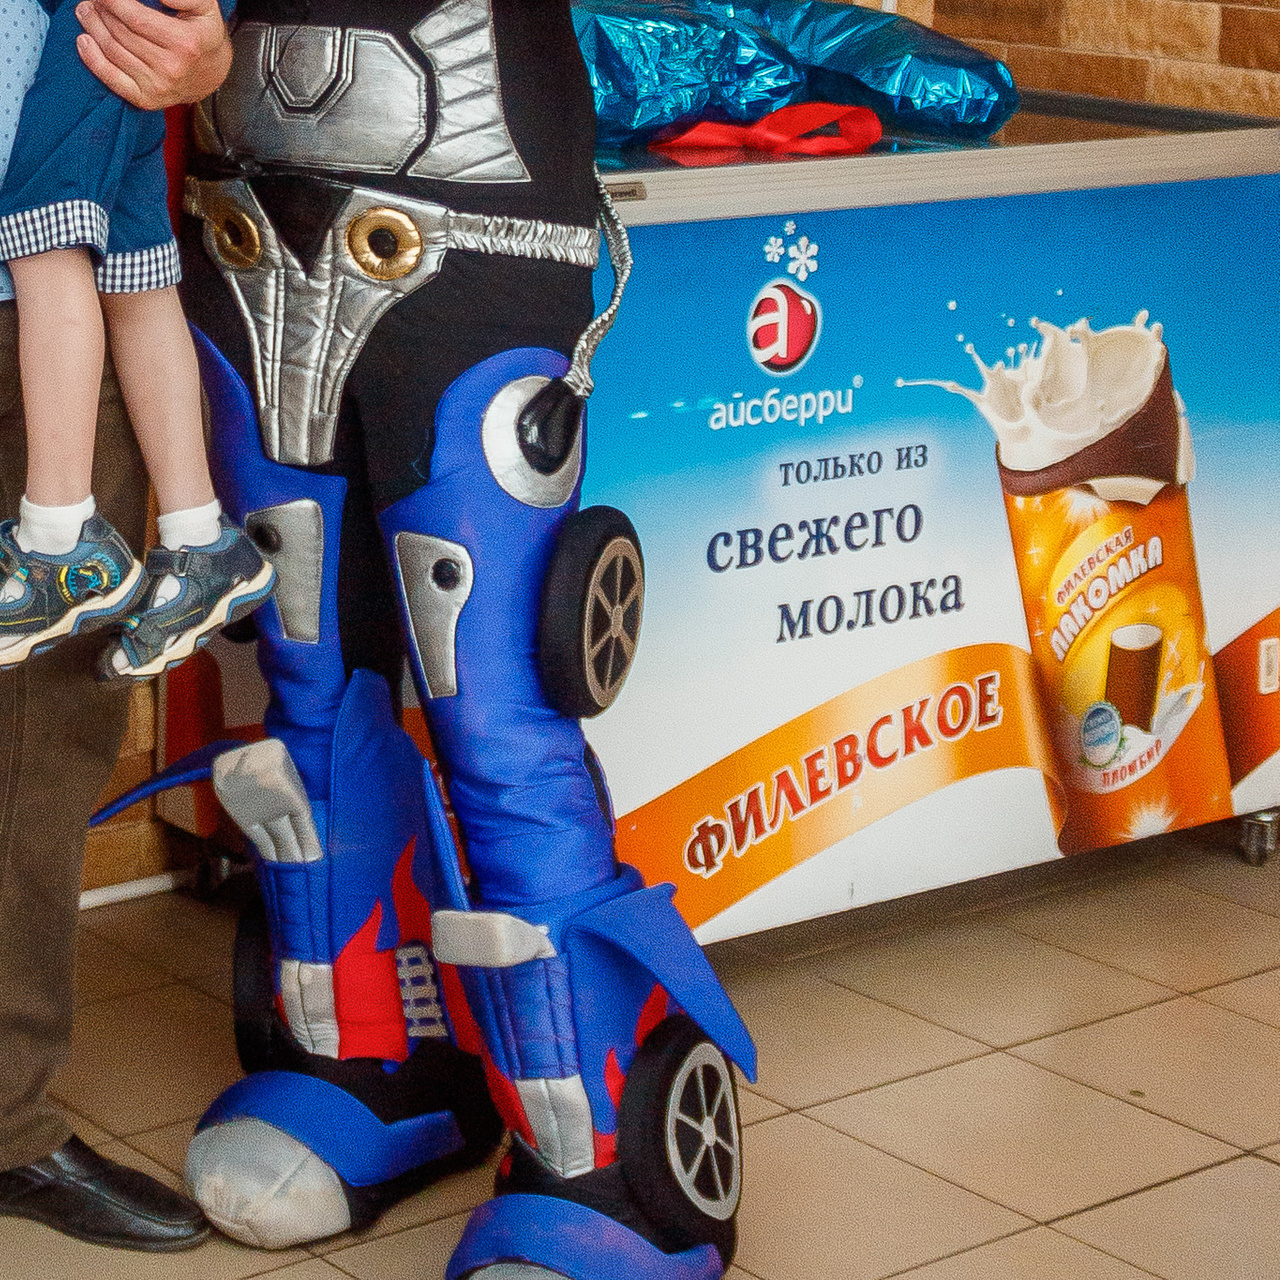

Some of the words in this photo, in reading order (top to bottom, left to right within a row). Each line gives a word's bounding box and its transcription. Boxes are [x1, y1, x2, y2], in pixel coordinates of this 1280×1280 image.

[779, 450, 883, 487] только
[895, 443, 929, 471] из
[706, 503, 924, 574] свежего
[1056, 526, 1134, 605] ФИЛЕВСКАЯ
[776, 574, 966, 644] молока
[1050, 536, 1164, 662] ЛАКОМКА
[683, 671, 1004, 878] ФИЛЕВСКОЕ
